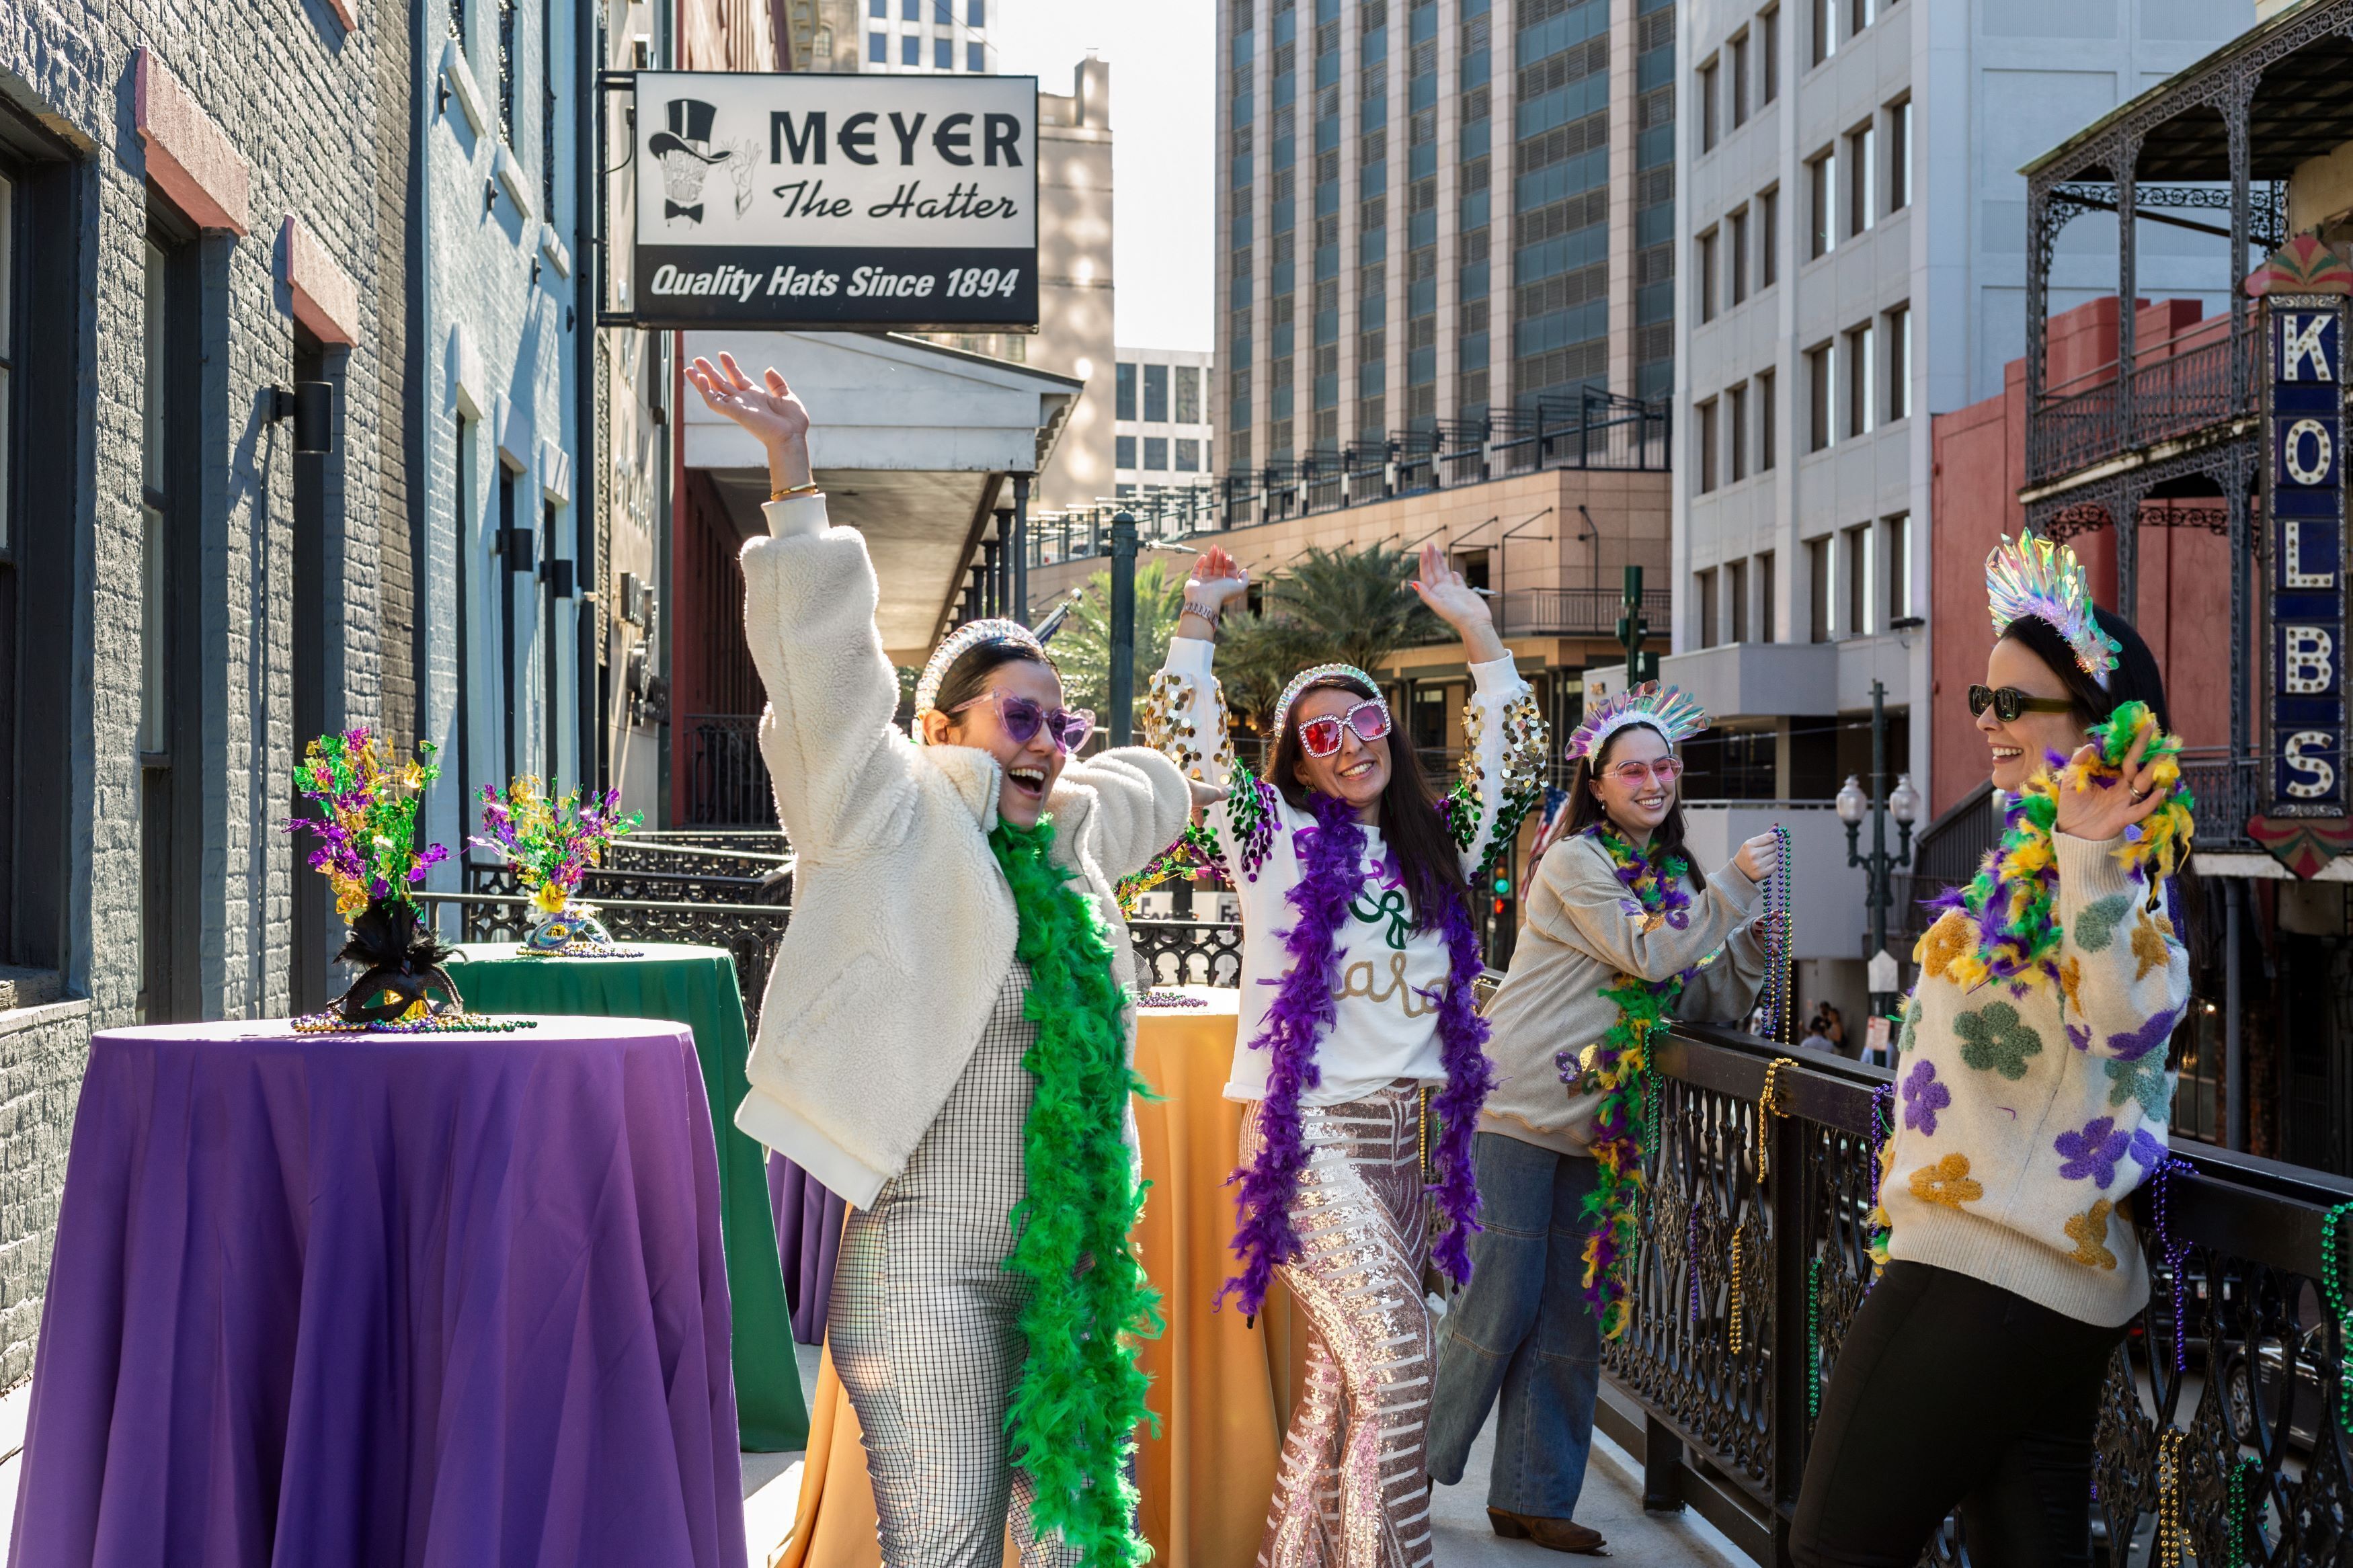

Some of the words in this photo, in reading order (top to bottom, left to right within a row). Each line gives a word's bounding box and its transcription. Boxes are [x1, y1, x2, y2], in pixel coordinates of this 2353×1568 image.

[770, 110, 1024, 167] MEYER
[772, 179, 852, 218] The
[867, 179, 1018, 219] Hatter
[650, 263, 763, 302] Quality
[766, 265, 838, 296] Hats
[846, 266, 935, 297] Since
[945, 268, 1020, 298] 1894
[2282, 313, 2336, 800] KOLBS
